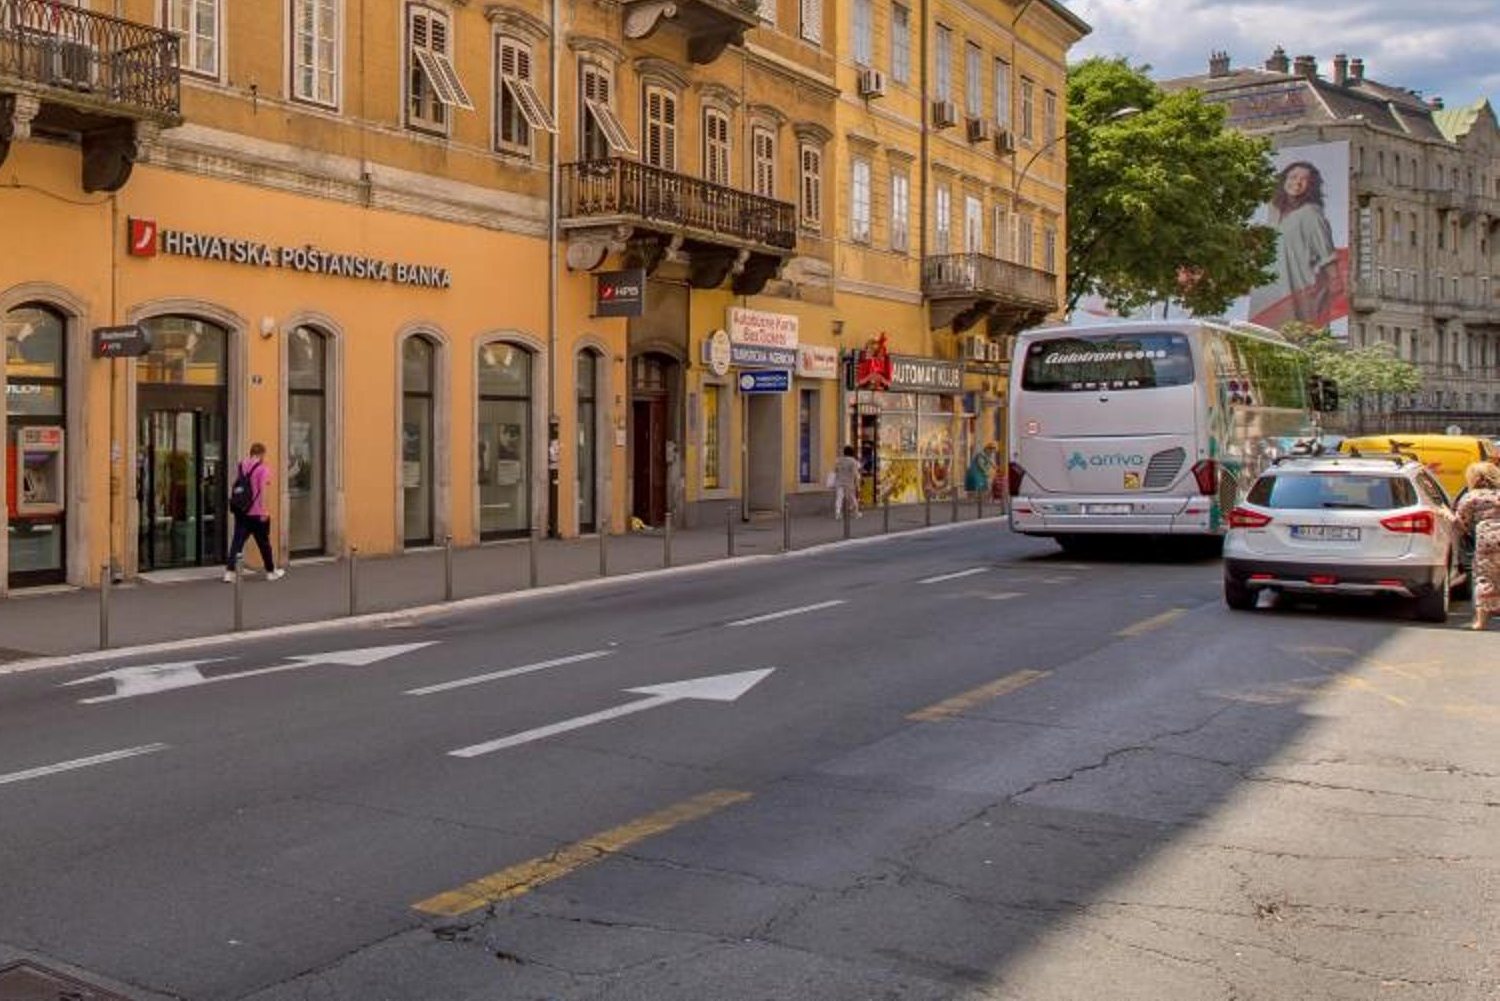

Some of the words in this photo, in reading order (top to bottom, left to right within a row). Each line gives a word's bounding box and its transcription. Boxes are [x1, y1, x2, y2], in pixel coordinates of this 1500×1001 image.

[162, 230, 274, 266] HRVATSKA
[279, 243, 391, 282] POŠTANSKA
[394, 262, 453, 289] BANKA
[890, 362, 937, 385] AUTOMAT
[1090, 453, 1144, 466] arriva
